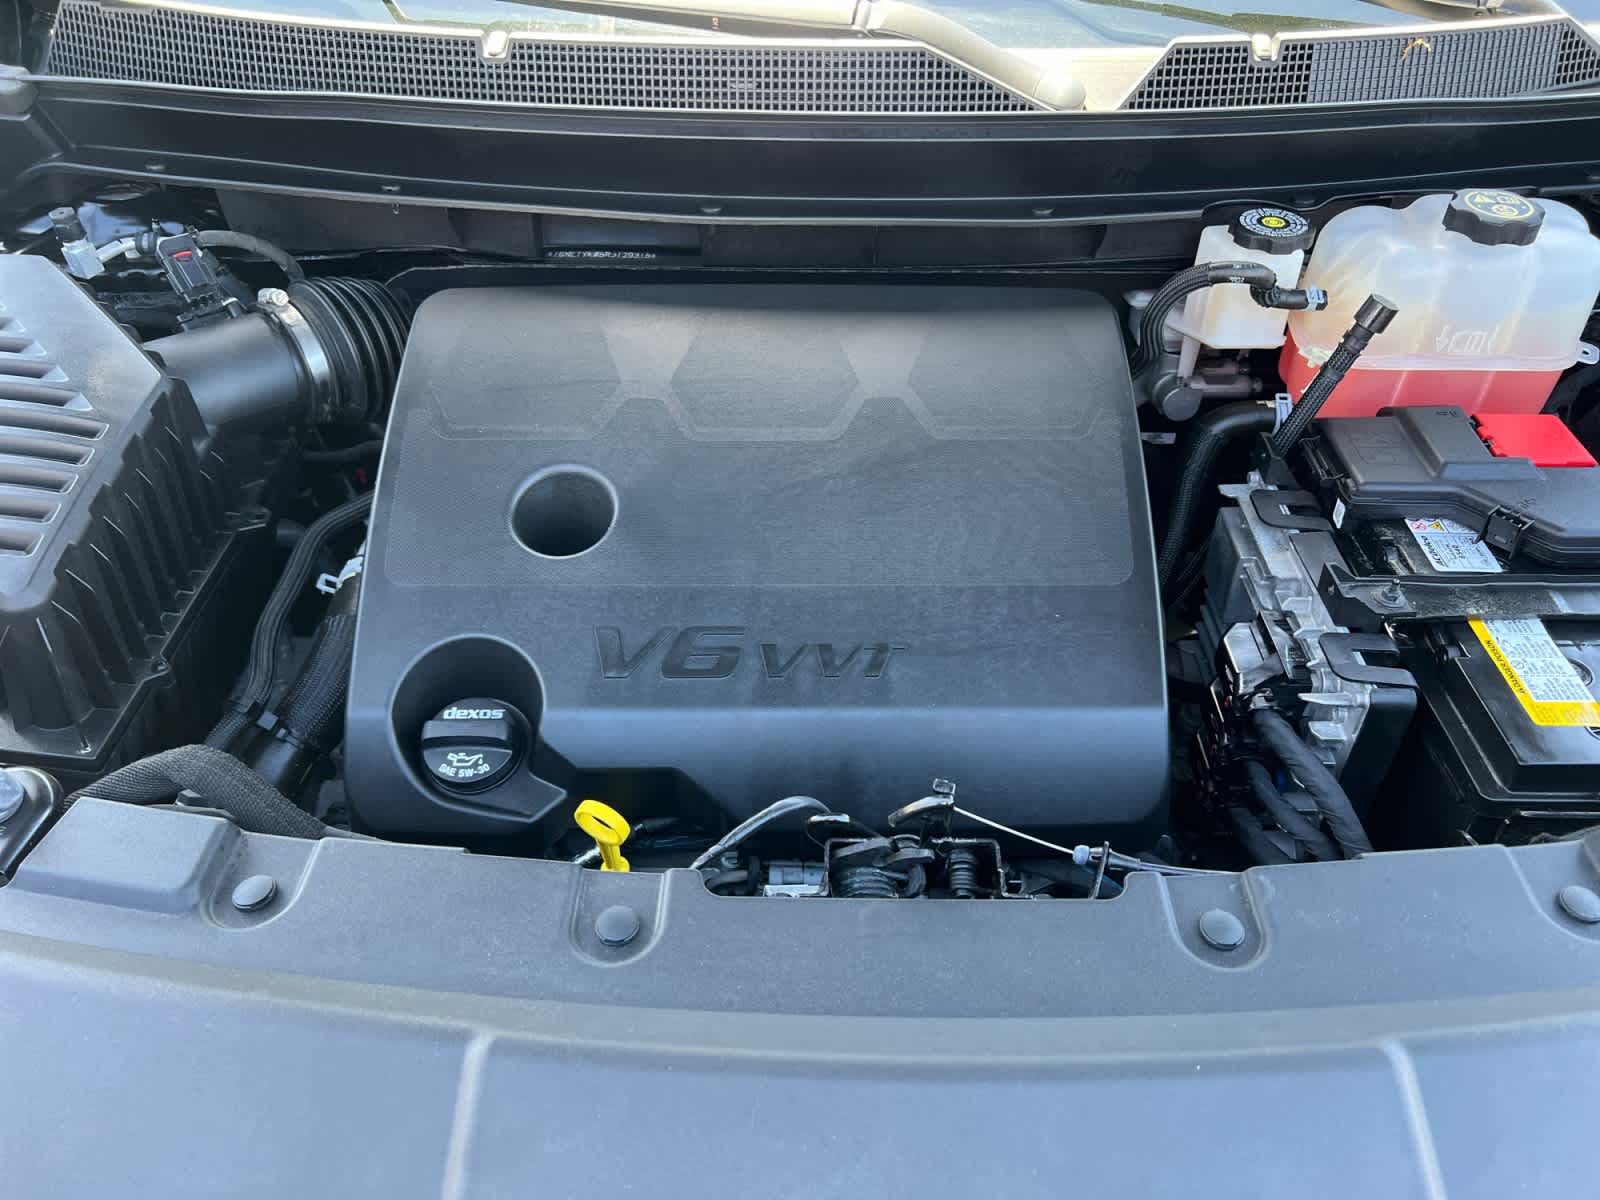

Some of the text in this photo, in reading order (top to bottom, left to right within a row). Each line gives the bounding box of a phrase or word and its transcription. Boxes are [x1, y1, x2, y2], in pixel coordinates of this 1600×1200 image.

[593, 625, 910, 679] V6 VVT
[443, 707, 506, 720] dexos
[438, 763, 490, 778] SAE 5W-30
